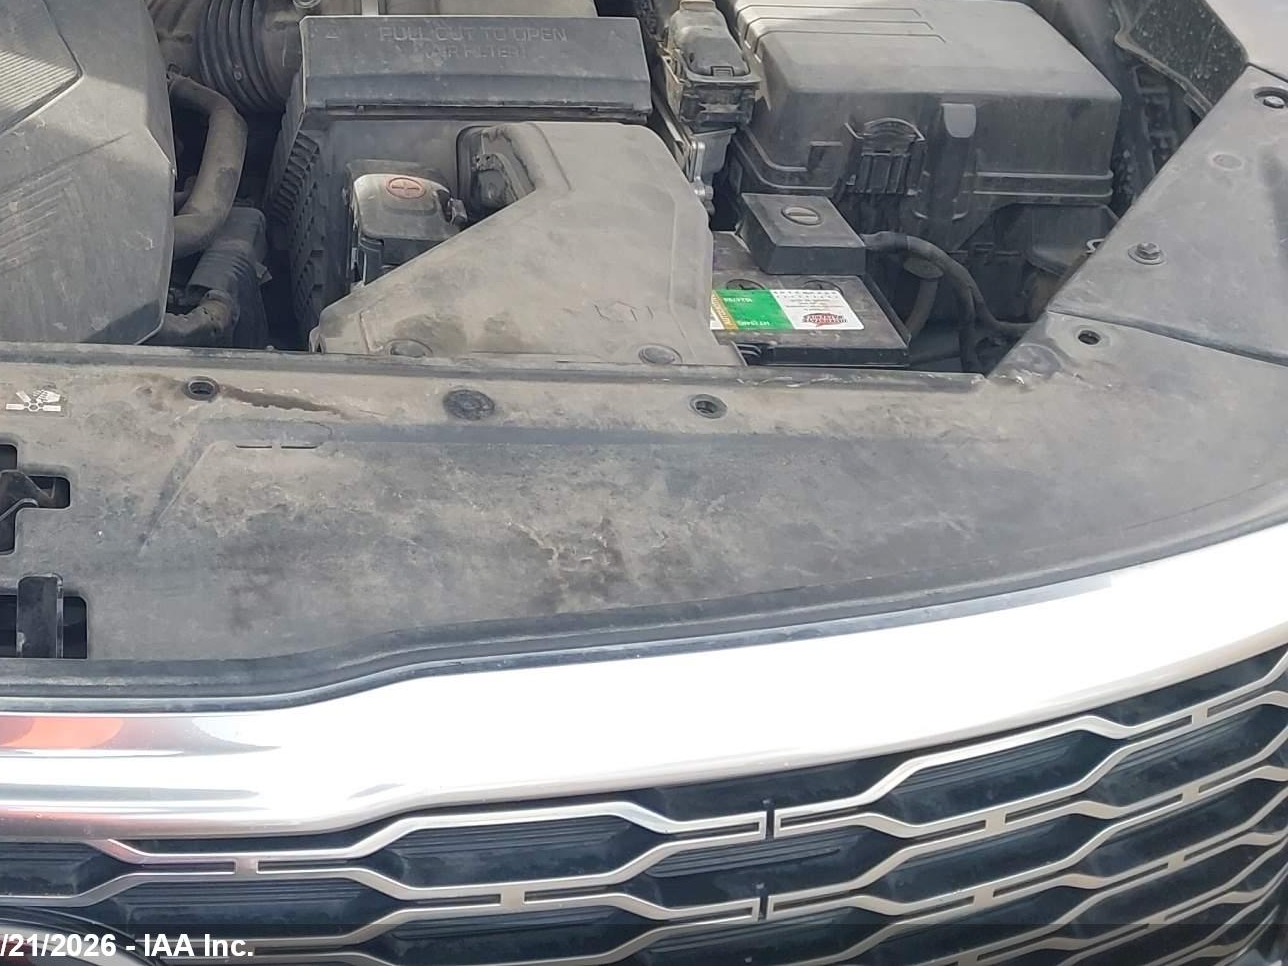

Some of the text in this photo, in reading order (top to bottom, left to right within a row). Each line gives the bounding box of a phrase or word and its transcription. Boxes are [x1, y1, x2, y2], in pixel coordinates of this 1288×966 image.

[379, 26, 568, 43] PULL OUT TO OPEN
